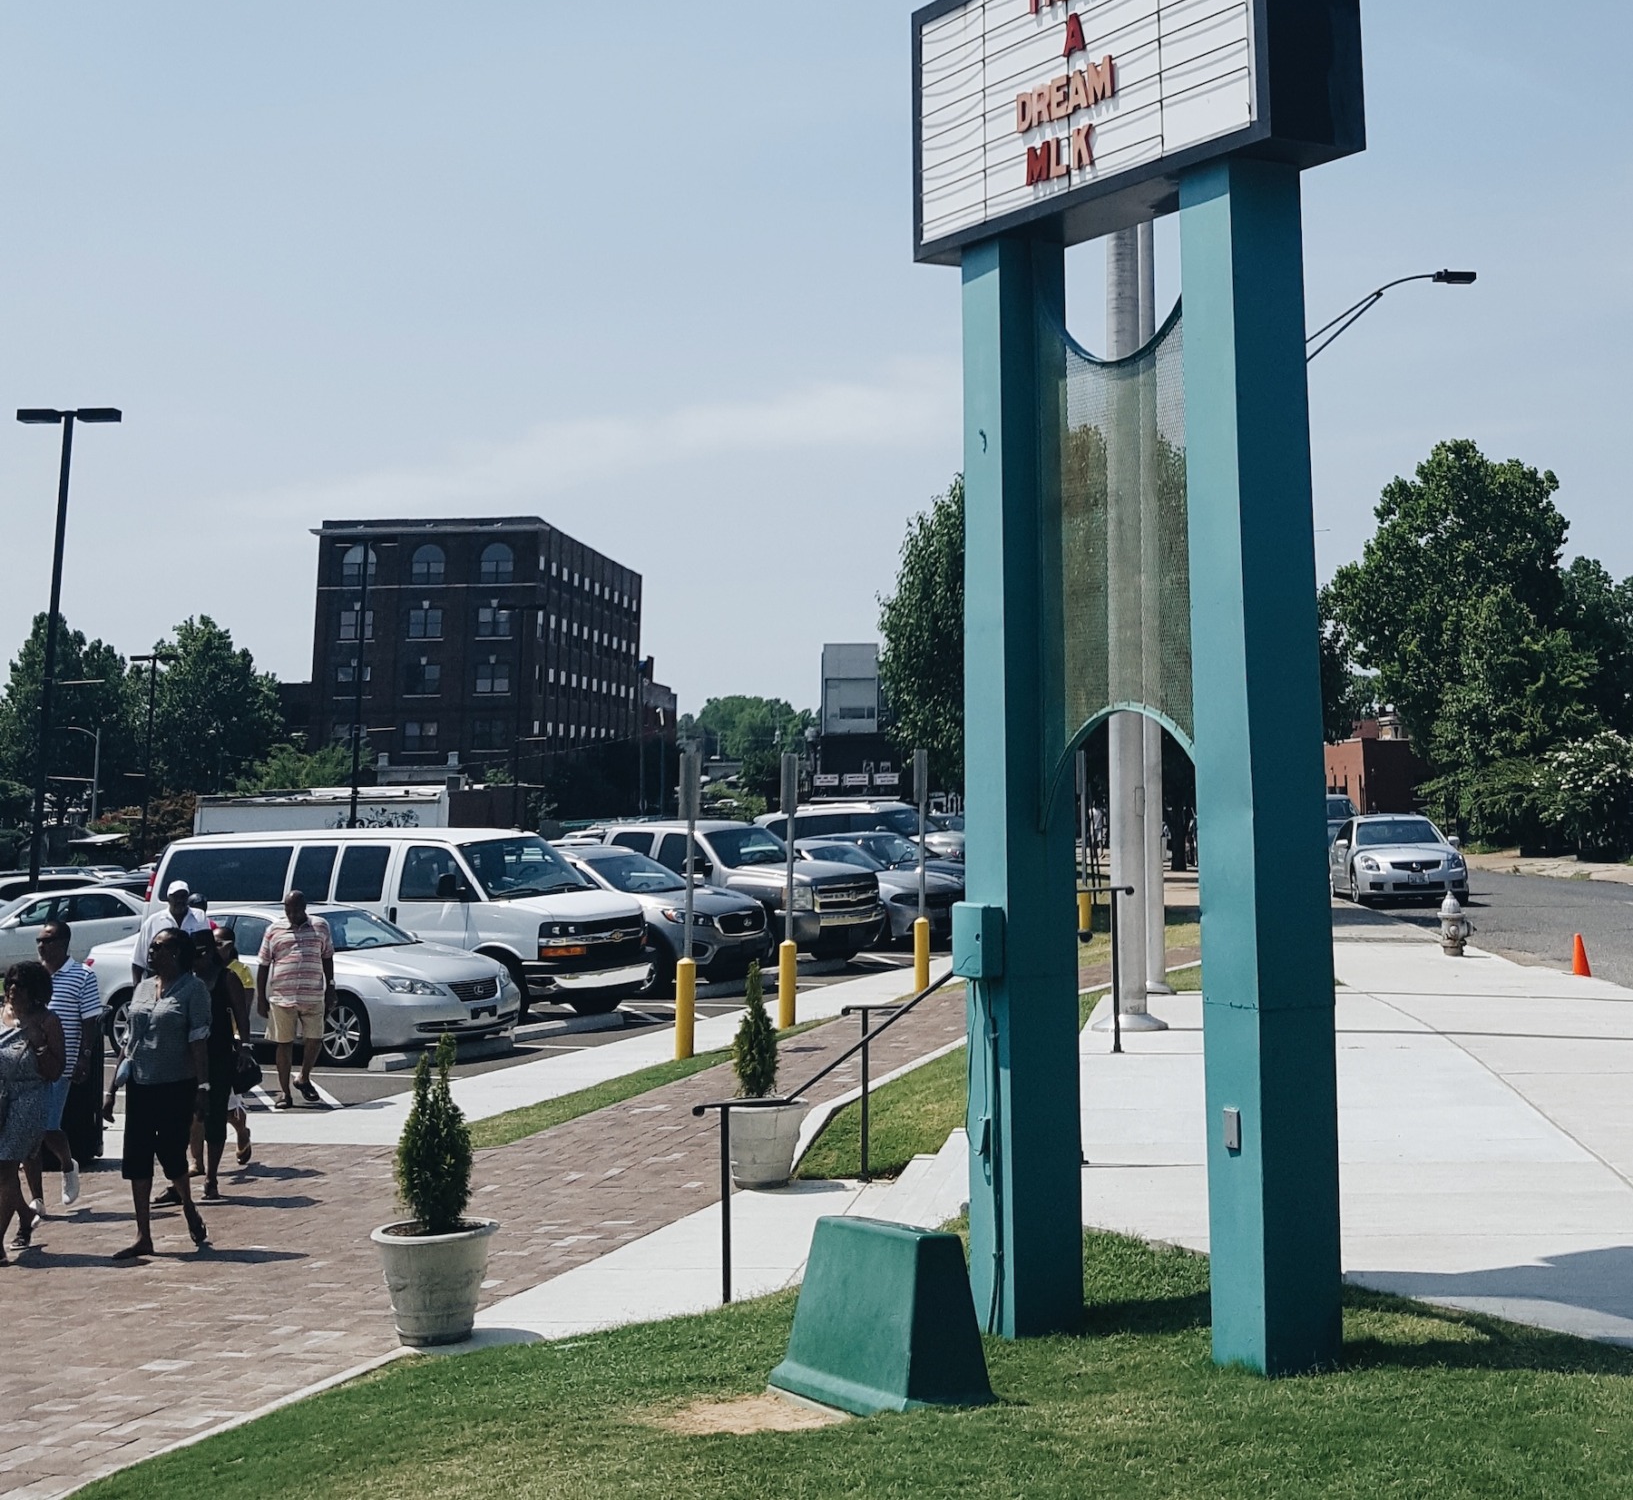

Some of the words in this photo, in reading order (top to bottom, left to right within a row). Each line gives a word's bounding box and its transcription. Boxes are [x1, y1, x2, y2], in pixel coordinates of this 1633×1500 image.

[1063, 12, 1085, 57] A
[1016, 54, 1115, 133] DREAM
[1026, 123, 1094, 186] MLK
